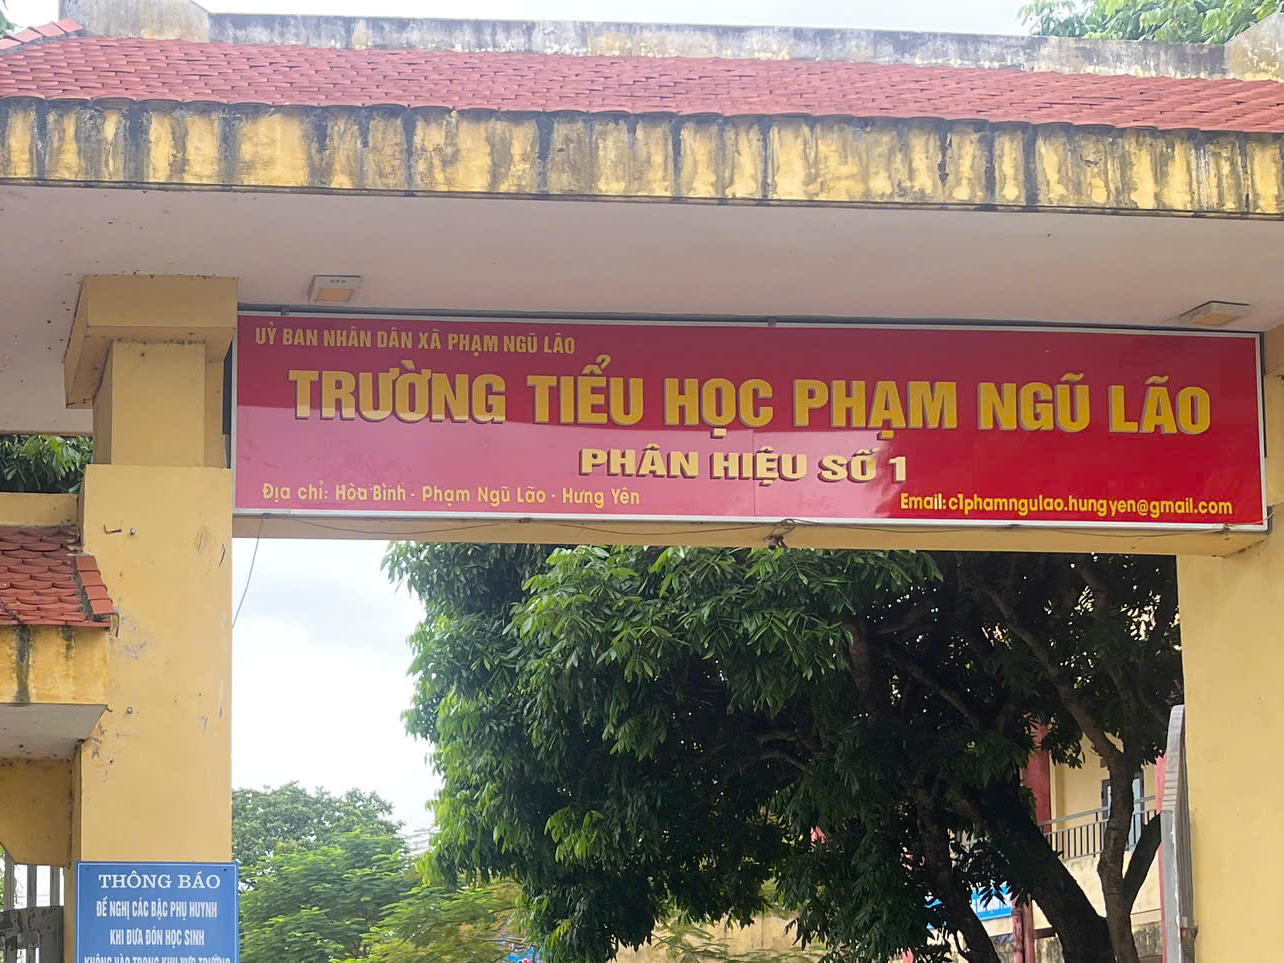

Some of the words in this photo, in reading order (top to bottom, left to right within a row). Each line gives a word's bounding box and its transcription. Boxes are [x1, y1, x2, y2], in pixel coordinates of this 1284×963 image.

[282, 328, 318, 346] BAN
[323, 326, 372, 348] NHÂN
[377, 326, 413, 349] DÂN
[418, 328, 442, 350] XÃ
[448, 333, 499, 357] PHẠM
[503, 332, 538, 354] NGŨ
[544, 333, 576, 355] LÃO
[288, 360, 507, 424] TRƯỜNG
[527, 354, 644, 426] TIỂU
[664, 377, 774, 439] HỌC
[792, 378, 958, 440] PHẠM
[977, 372, 1091, 432] NGŨ
[1108, 375, 1211, 435] LÃO
[579, 443, 699, 478] PHÂN
[710, 446, 808, 487] HIỆU
[817, 448, 882, 483] SỐ
[889, 456, 907, 483] 1
[262, 482, 291, 503] Địa
[297, 481, 328, 500] chỉ:
[372, 483, 406, 501] Bình
[421, 485, 471, 508] Phạm
[477, 485, 511, 508] Ngũ
[516, 485, 547, 505] Lão
[562, 487, 604, 509] Hưng
[610, 487, 640, 506] Yên
[98, 870, 173, 889] THÔNG
[177, 871, 221, 889] BÁO
[109, 900, 130, 920] NGHỊ
[132, 897, 149, 918] CÁC
[151, 898, 168, 920] BẬC
[170, 901, 187, 920] PHỤ
[110, 929, 124, 945] KHI
[126, 927, 143, 945] ĐƯA
[145, 925, 163, 945] ĐÓN
[165, 929, 182, 948] HỌC
[184, 929, 204, 946] SINH
